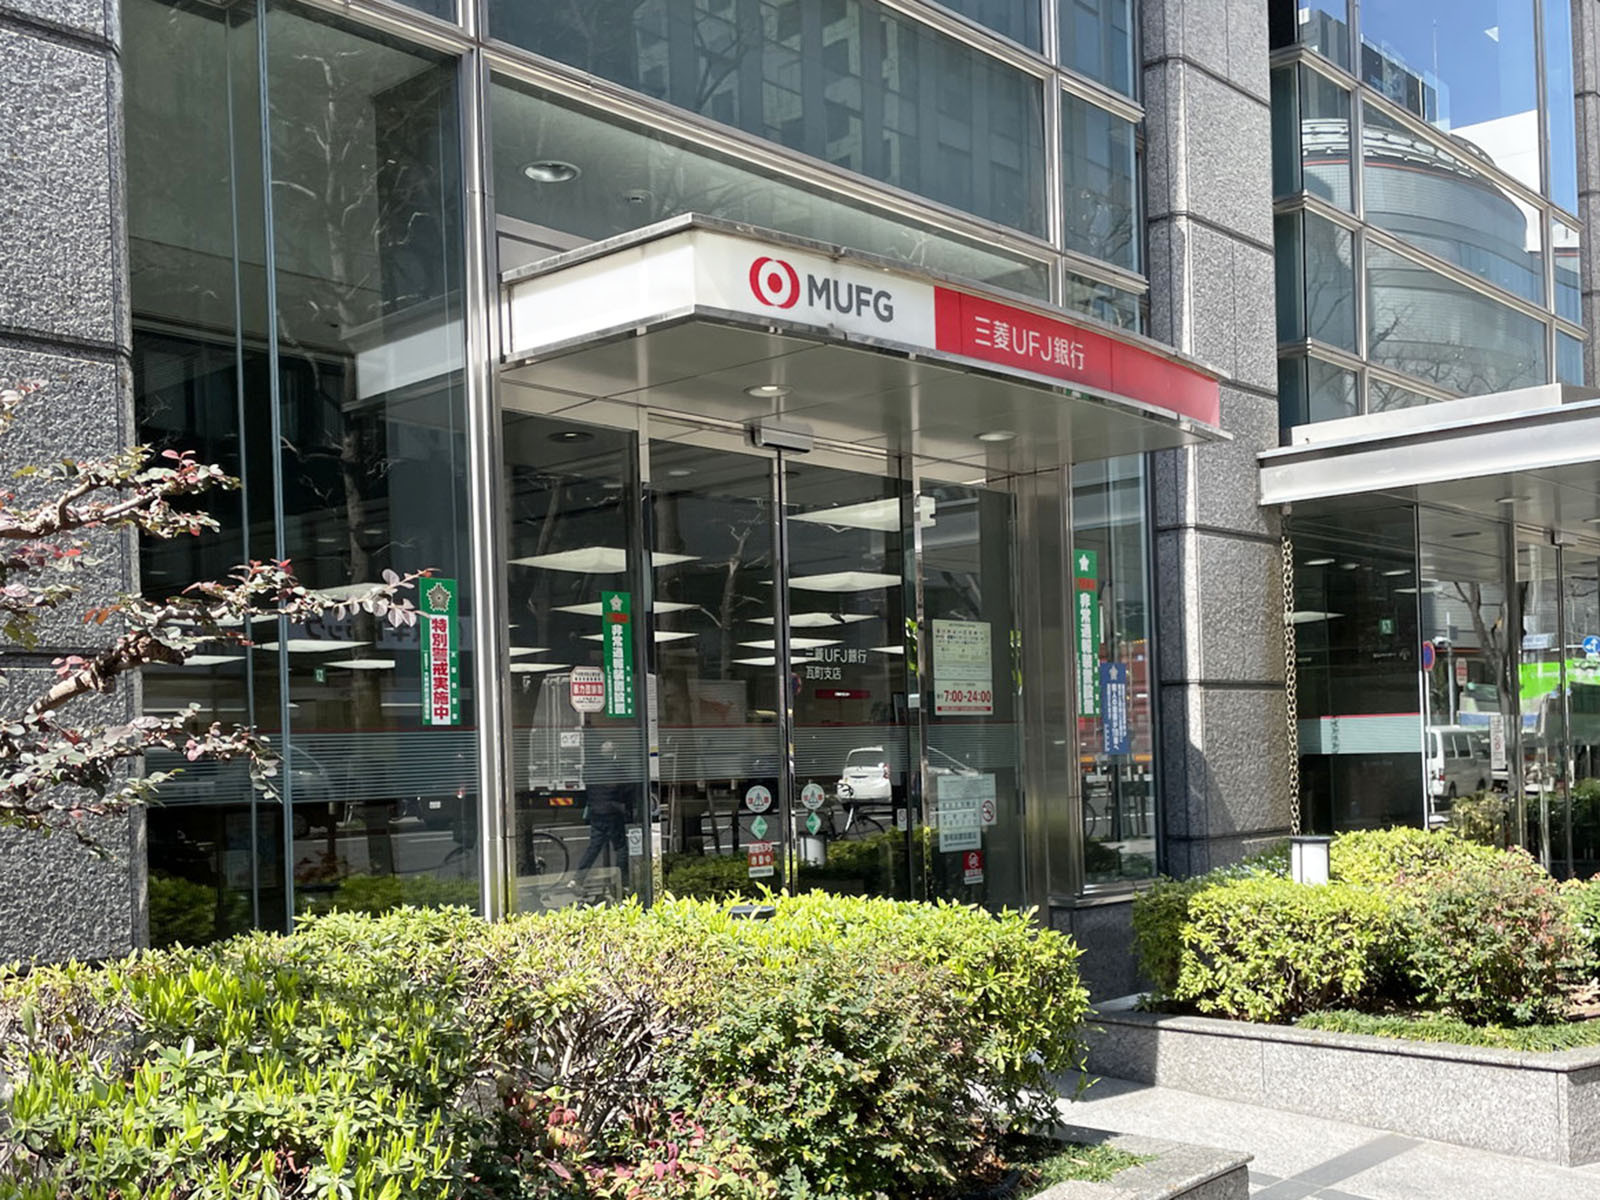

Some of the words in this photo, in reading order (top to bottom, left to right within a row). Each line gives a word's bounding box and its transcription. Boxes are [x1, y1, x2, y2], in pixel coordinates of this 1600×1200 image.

[806, 274, 894, 323] MUFG
[974, 316, 1085, 370] 三菱UFJ銀行
[805, 665, 842, 681] 瓦町支店
